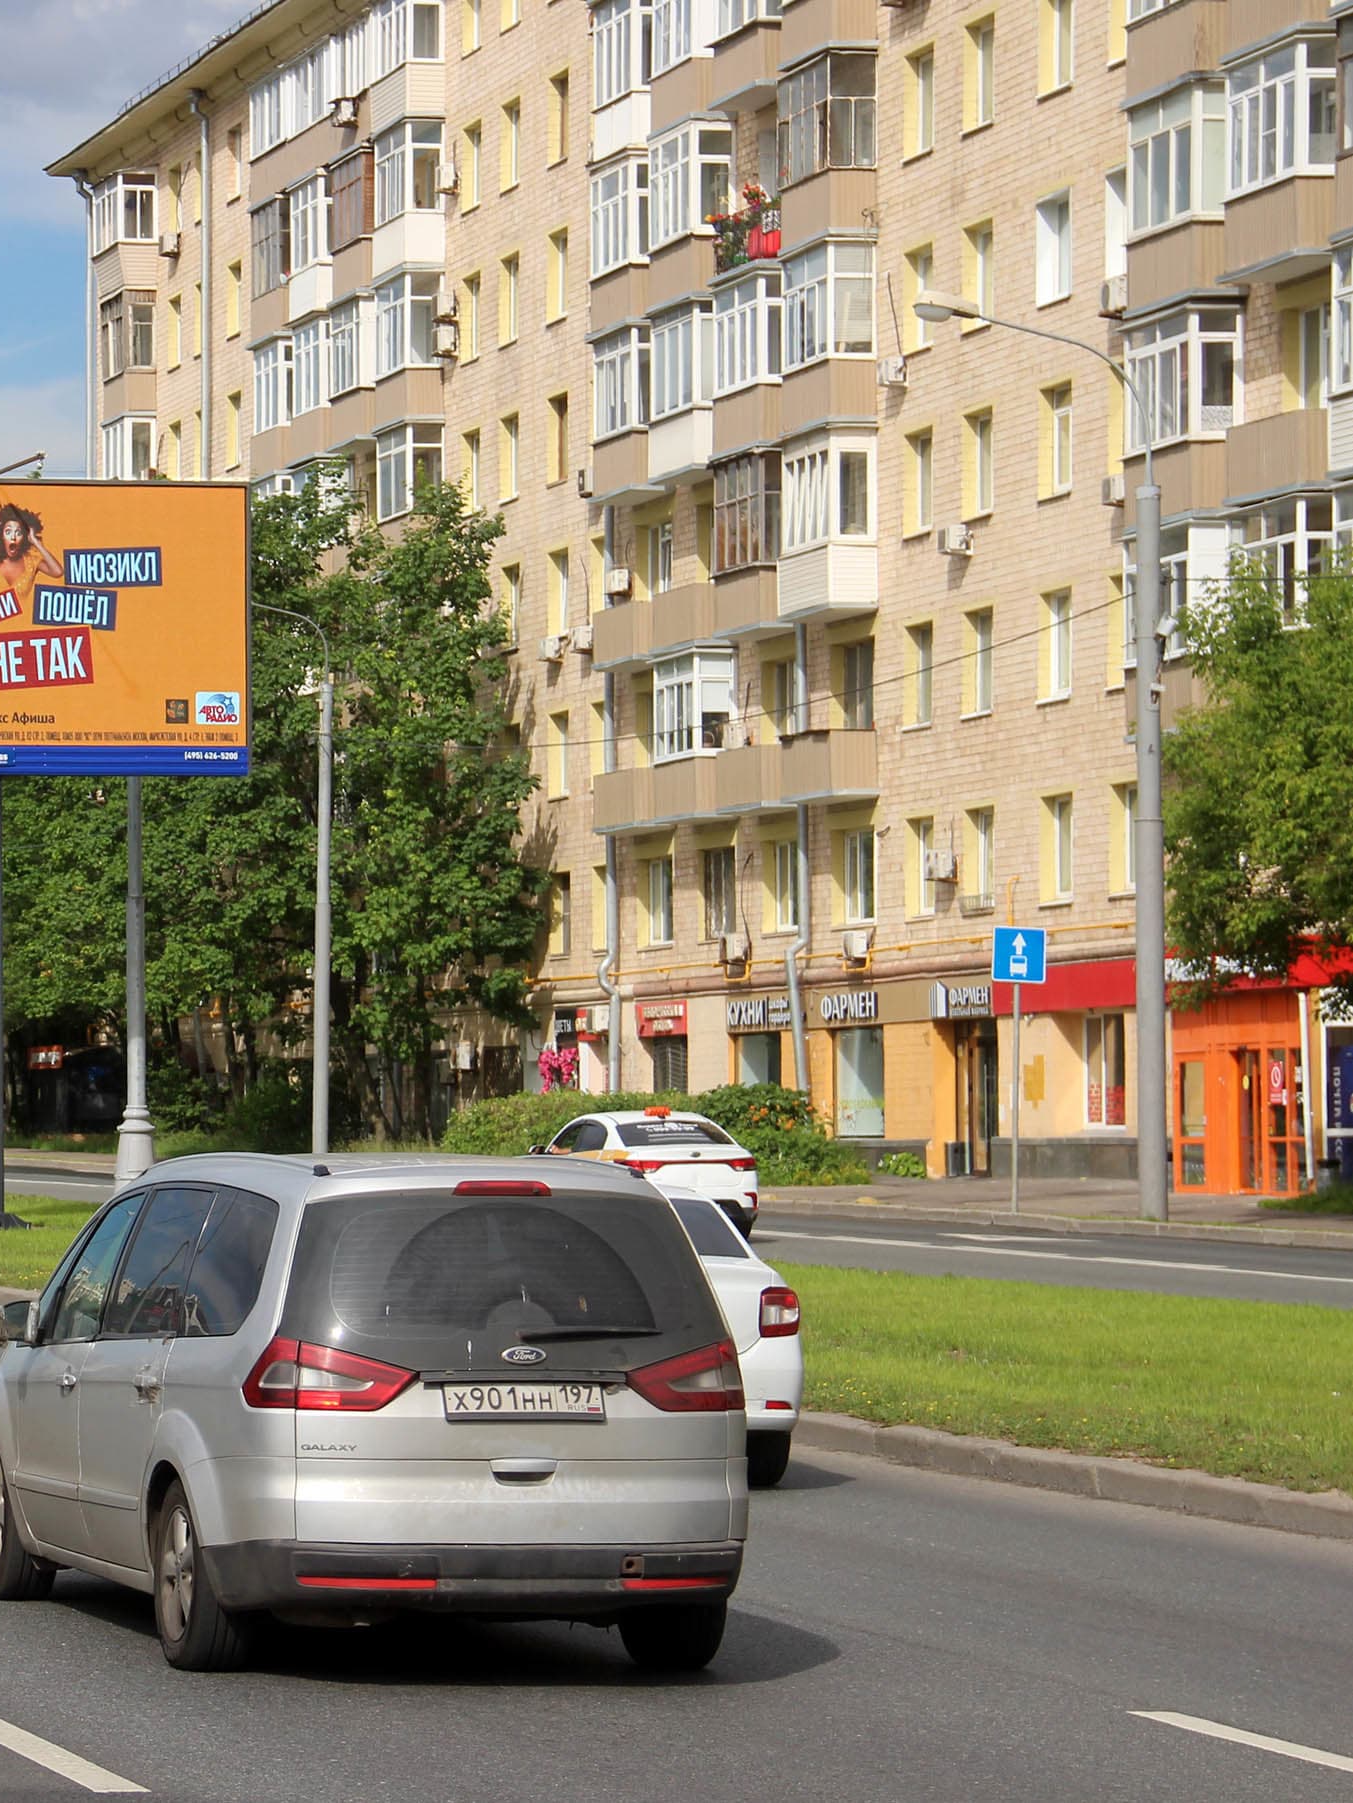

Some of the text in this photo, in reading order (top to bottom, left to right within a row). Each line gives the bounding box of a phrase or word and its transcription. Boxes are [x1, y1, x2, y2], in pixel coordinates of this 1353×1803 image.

[69, 551, 157, 584] МЮЗИКЛ
[39, 589, 109, 626] ПОШЁЛ
[30, 636, 87, 681] ТАК
[12, 712, 55, 724] Афиша
[198, 705, 224, 714] АВТО
[206, 713, 238, 723] РАДИО
[820, 992, 876, 1020] ФАРМЕН
[950, 986, 989, 1006] ФАРМЕН
[727, 999, 764, 1026] КУХНИ
[513, 1350, 537, 1360] Ford
[559, 1384, 594, 1404] 197
